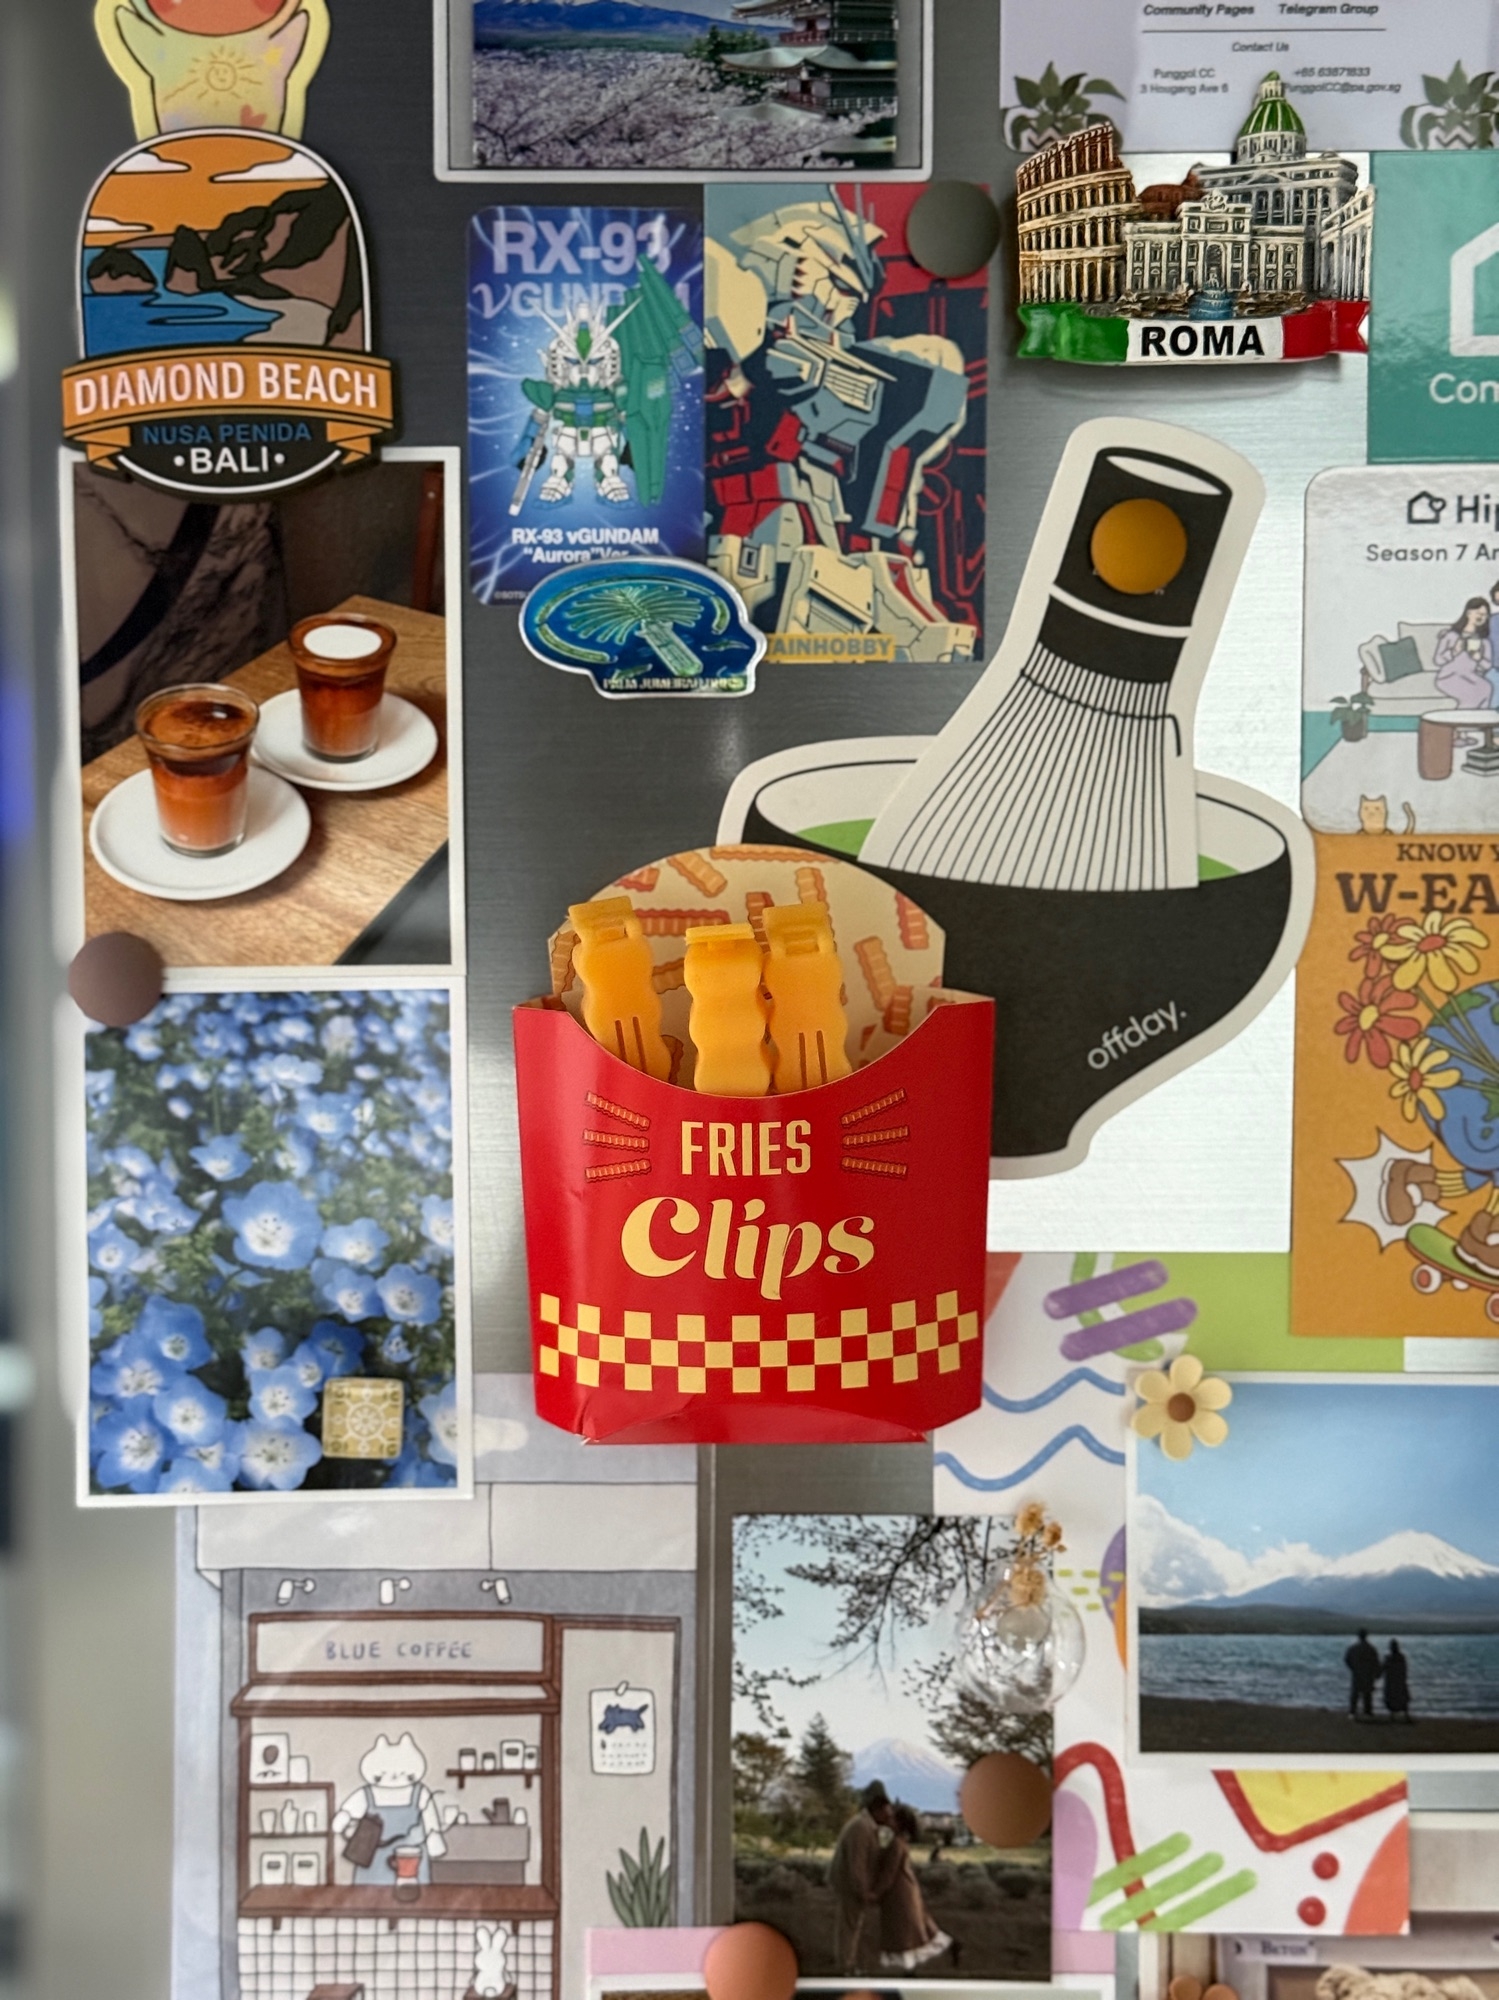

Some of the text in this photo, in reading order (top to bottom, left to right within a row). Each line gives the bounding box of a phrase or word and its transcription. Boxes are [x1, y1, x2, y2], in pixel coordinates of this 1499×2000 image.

[1143, 4, 1254, 17] Community Pages
[1279, 3, 1379, 16] Telegram Group
[1231, 41, 1289, 52] Contact Us
[1199, 67, 1215, 79] CC
[493, 220, 671, 275] RX-93
[1141, 325, 1265, 356] ROMA
[74, 361, 377, 416] DIAMOND BEACH
[143, 422, 312, 446] NUSA PENIDA
[190, 446, 269, 474] BALI
[511, 527, 564, 545] RX-93
[1366, 543, 1448, 561] Season
[1455, 544, 1468, 561] 7
[768, 637, 893, 656] AINHOBBY
[1396, 843, 1484, 862] KNOW
[1087, 1000, 1187, 1070] offday.
[681, 1119, 811, 1177] FRIES
[620, 1196, 875, 1301] Clips
[326, 1641, 473, 1661] BLUE COFFEE
